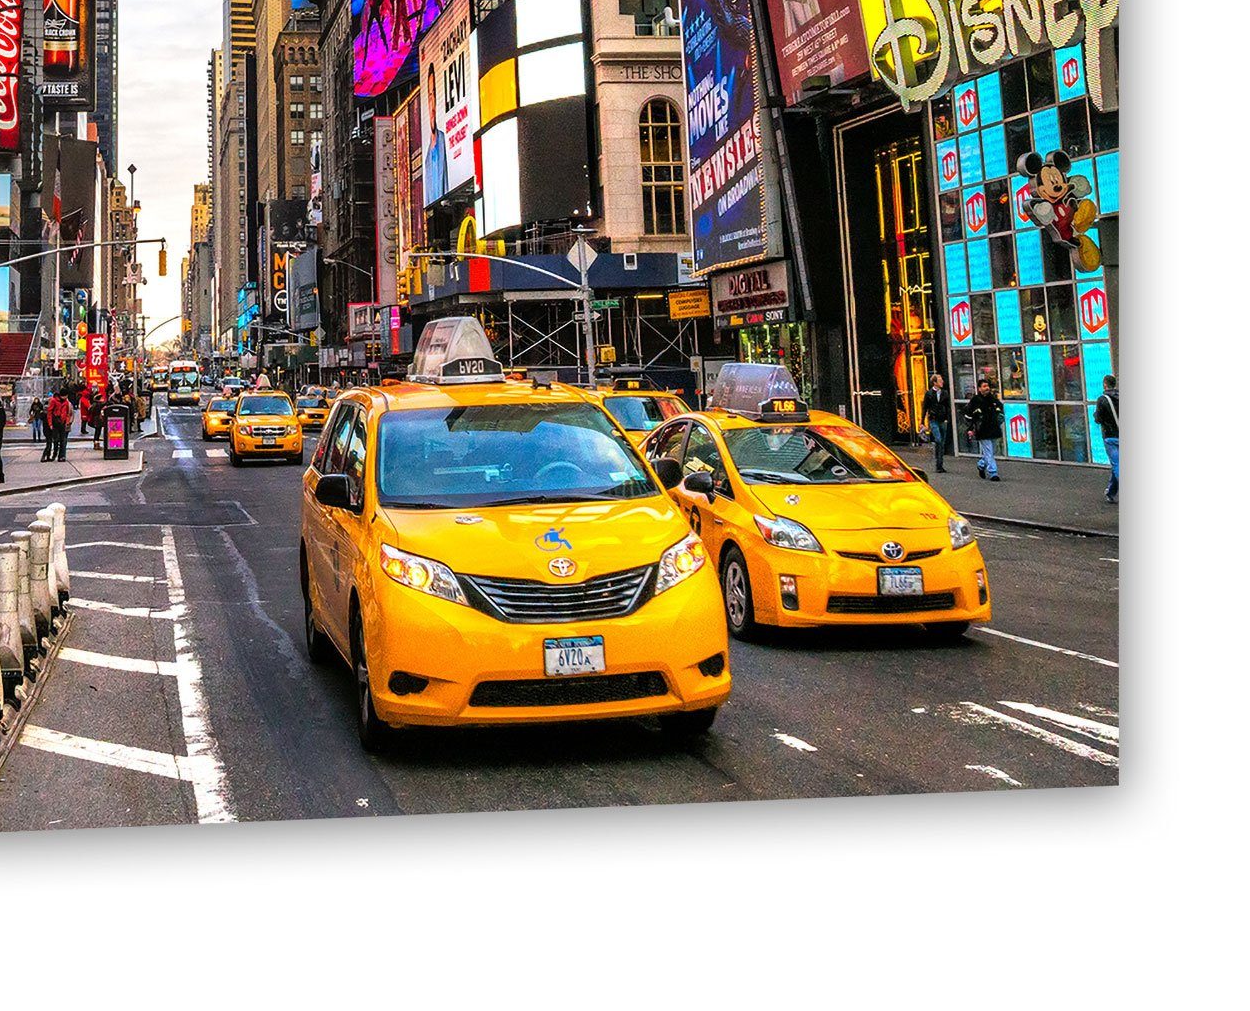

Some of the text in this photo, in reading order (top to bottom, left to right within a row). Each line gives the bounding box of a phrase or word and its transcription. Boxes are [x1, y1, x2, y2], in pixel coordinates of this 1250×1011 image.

[441, 16, 468, 63] ZACHARY
[443, 50, 466, 114] LEVI
[623, 65, 649, 79] THE
[688, 70, 715, 109] NOTHING
[688, 75, 729, 146] MOVES
[959, 92, 975, 123] IN
[715, 115, 729, 142] LIKE
[717, 197, 728, 217] ON
[729, 270, 771, 296] DIGITAL
[765, 309, 784, 321] SONY
[952, 305, 972, 337] IN
[1081, 292, 1107, 332] IN
[91, 336, 105, 367] tkts
[772, 400, 797, 412] 7L66
[558, 646, 584, 666] 6V20
